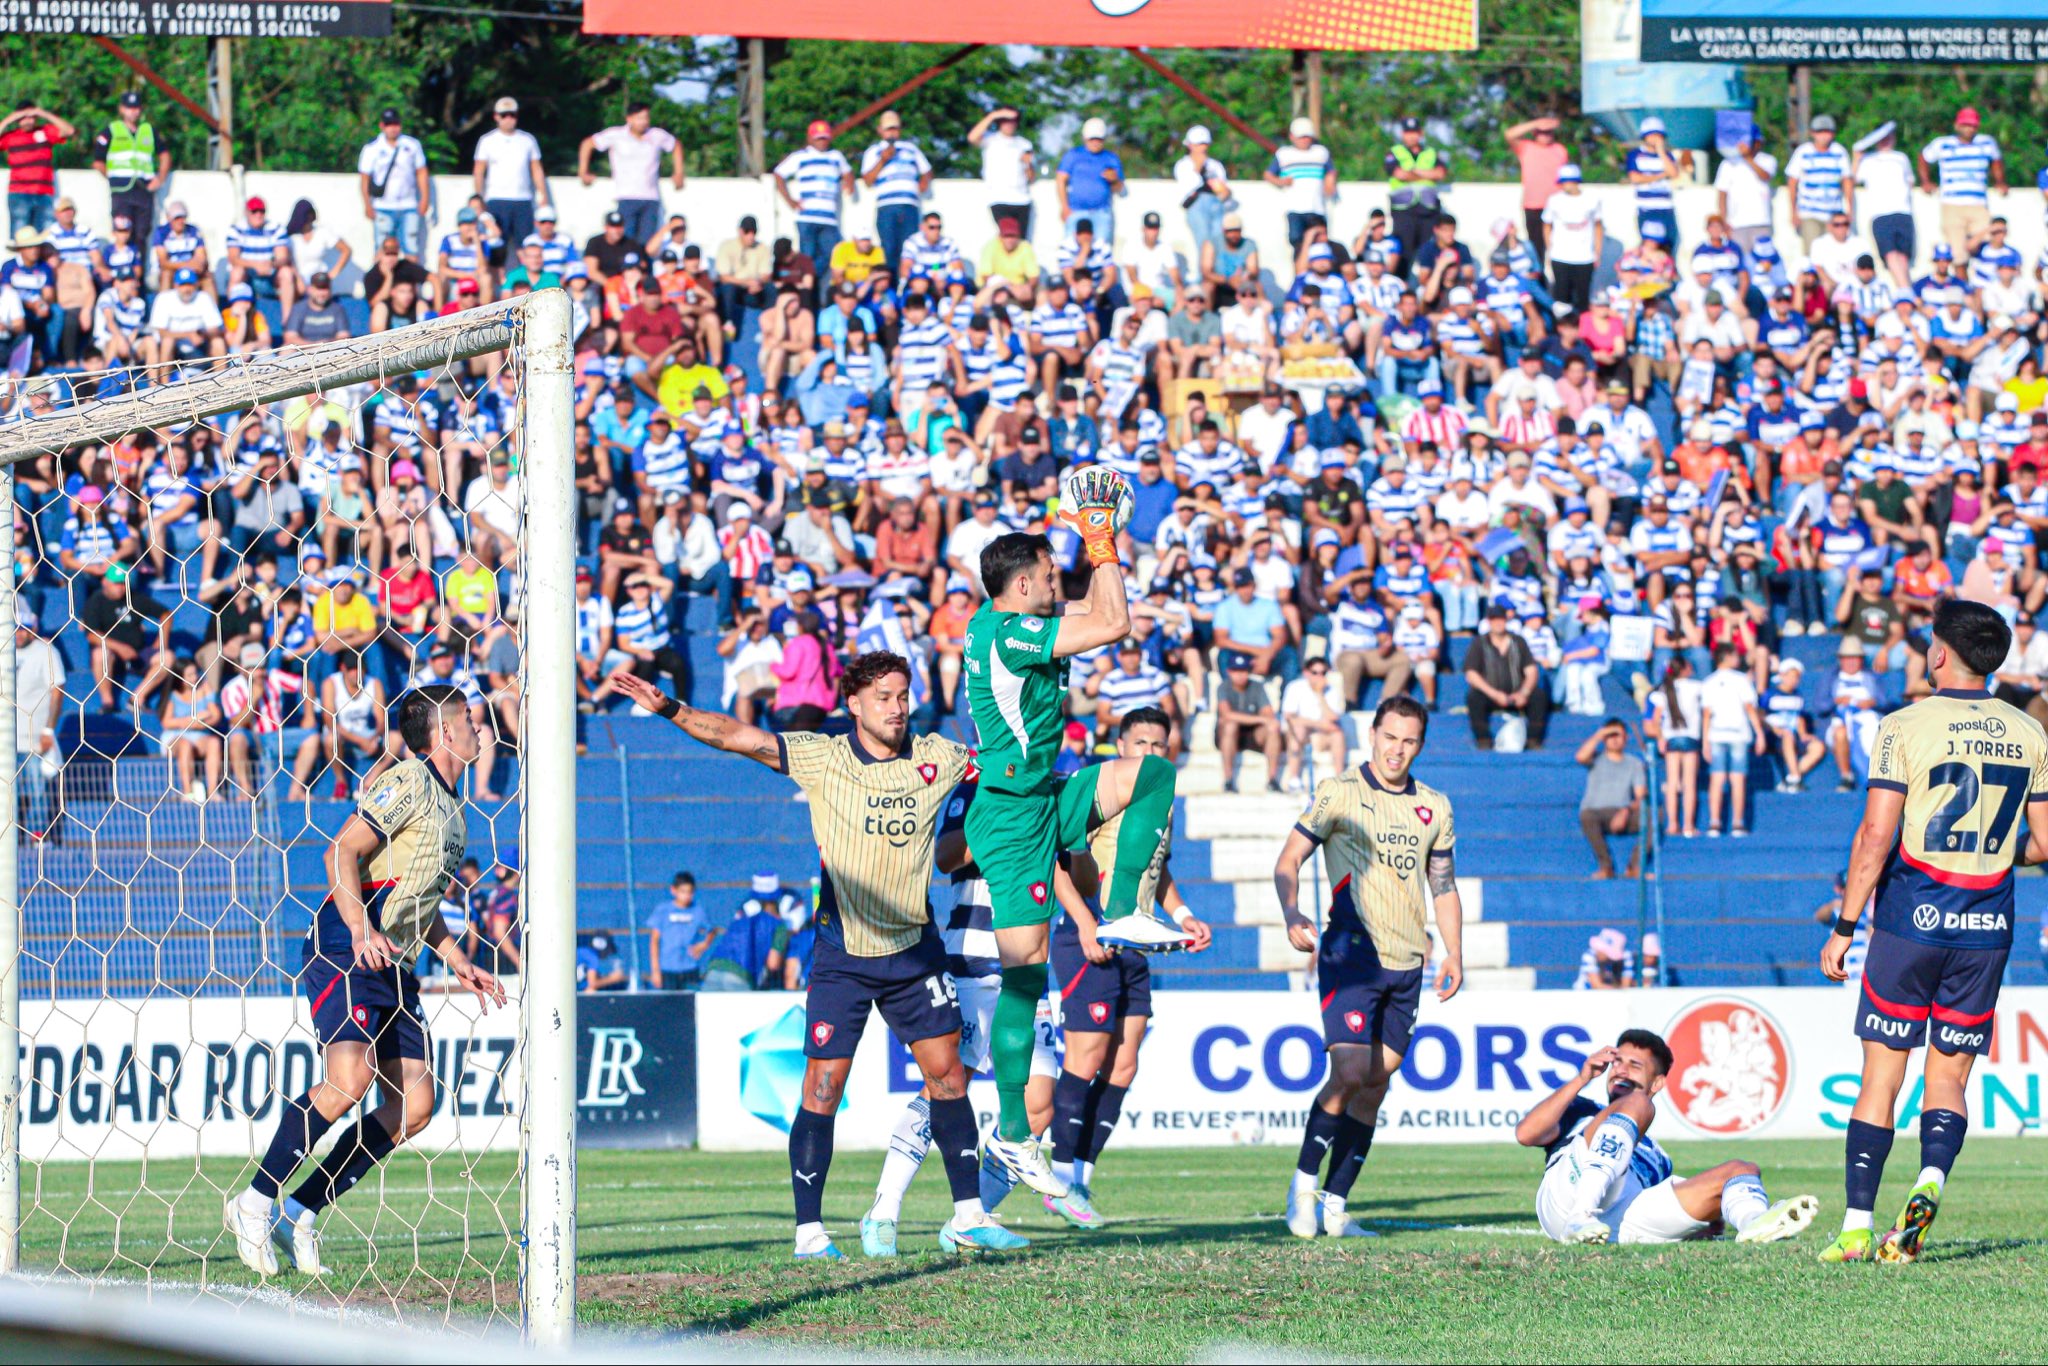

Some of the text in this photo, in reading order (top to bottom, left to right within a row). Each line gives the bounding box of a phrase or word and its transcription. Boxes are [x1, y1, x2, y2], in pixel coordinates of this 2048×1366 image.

[152, 2, 169, 19] EL
[176, 2, 251, 20] CONSUMO
[256, 4, 277, 20] EN
[283, 4, 341, 22] EXCESO
[24, 16, 75, 33] SALUD
[153, 19, 163, 34] Y
[168, 18, 252, 35] BIENESTAR
[1670, 26, 1693, 43] LA
[1694, 26, 1748, 42] VENTA
[1749, 26, 1770, 42] ES
[1772, 26, 1861, 43] PROHIBIDA
[1862, 27, 1906, 42] PARA
[1907, 27, 1986, 43] MENORES
[1987, 27, 2009, 43] DE
[1700, 42, 1752, 59] CAUSA
[1814, 43, 1827, 59] A
[1829, 43, 1850, 59] LA
[1935, 43, 2012, 61] ADVIERTE
[2014, 44, 2036, 61] EL
[1947, 740, 2023, 760] J. TORRES
[867, 795, 917, 810] ueno
[1923, 761, 2031, 855] 27
[1376, 831, 1419, 848] ueno
[1943, 912, 2008, 931] DIESA
[1940, 1025, 1984, 1048] ueno
[1192, 1023, 1592, 1092] COORS
[1399, 1109, 1530, 1128] ACRILICO
